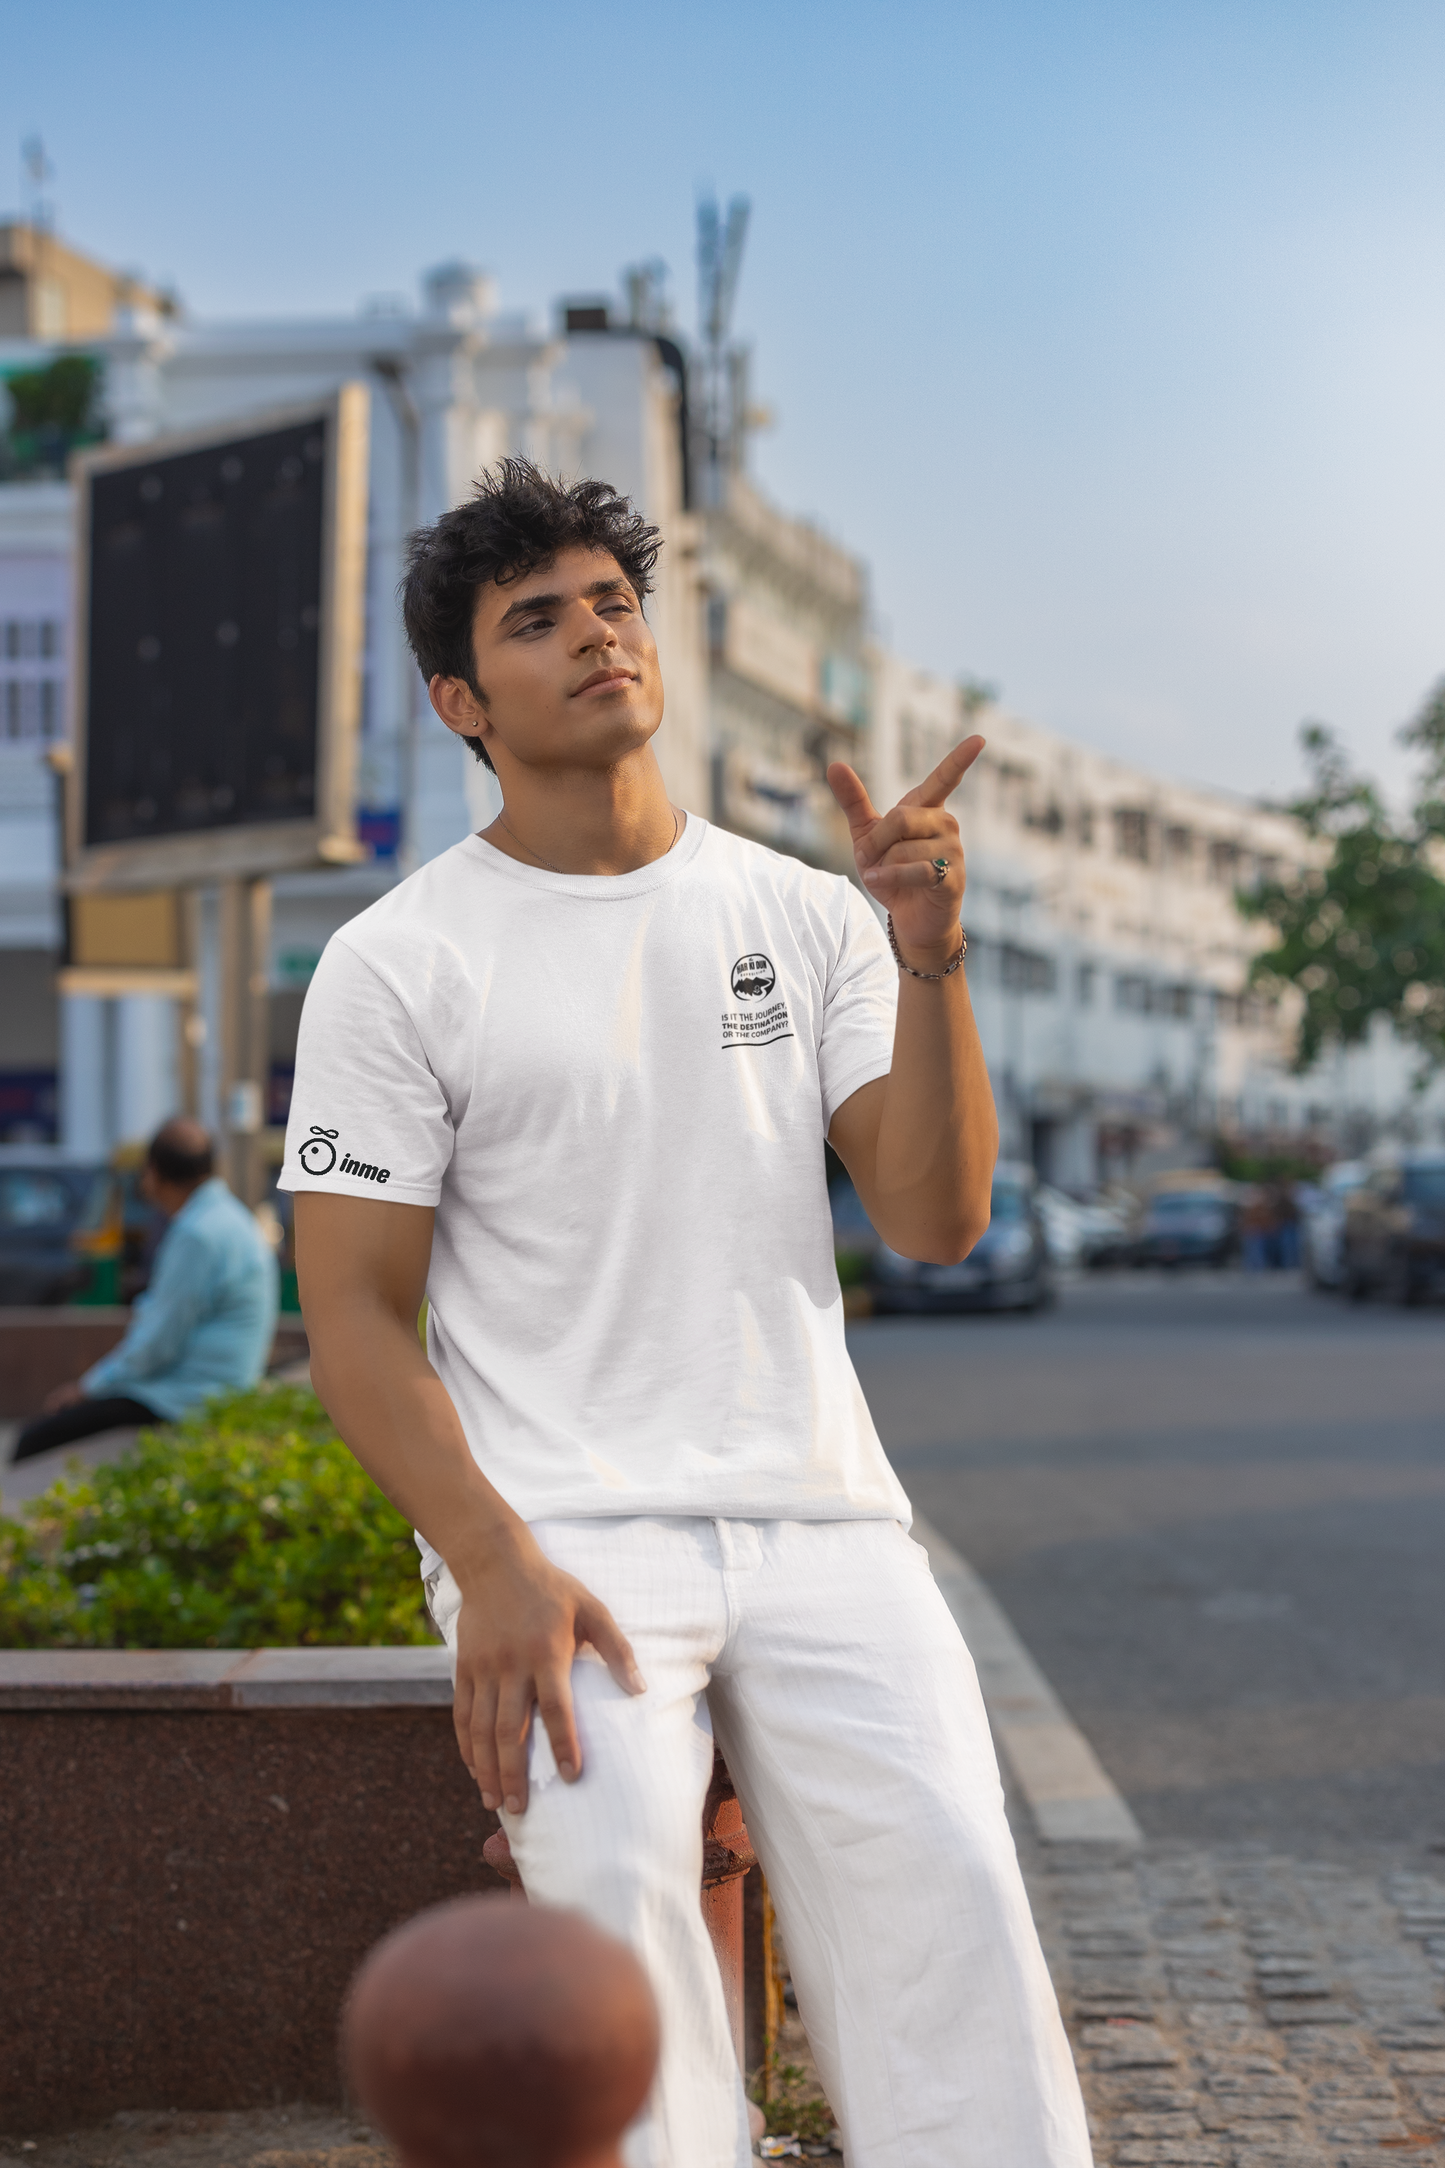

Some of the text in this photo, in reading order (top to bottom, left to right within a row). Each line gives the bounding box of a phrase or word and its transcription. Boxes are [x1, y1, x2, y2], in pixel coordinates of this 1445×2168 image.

[721, 1002, 787, 1021] IS IT THE JOURNEY,
[740, 1011, 788, 1030] DESTINATION
[751, 1020, 789, 1038] COMPANY?
[339, 1153, 391, 1184] inme
